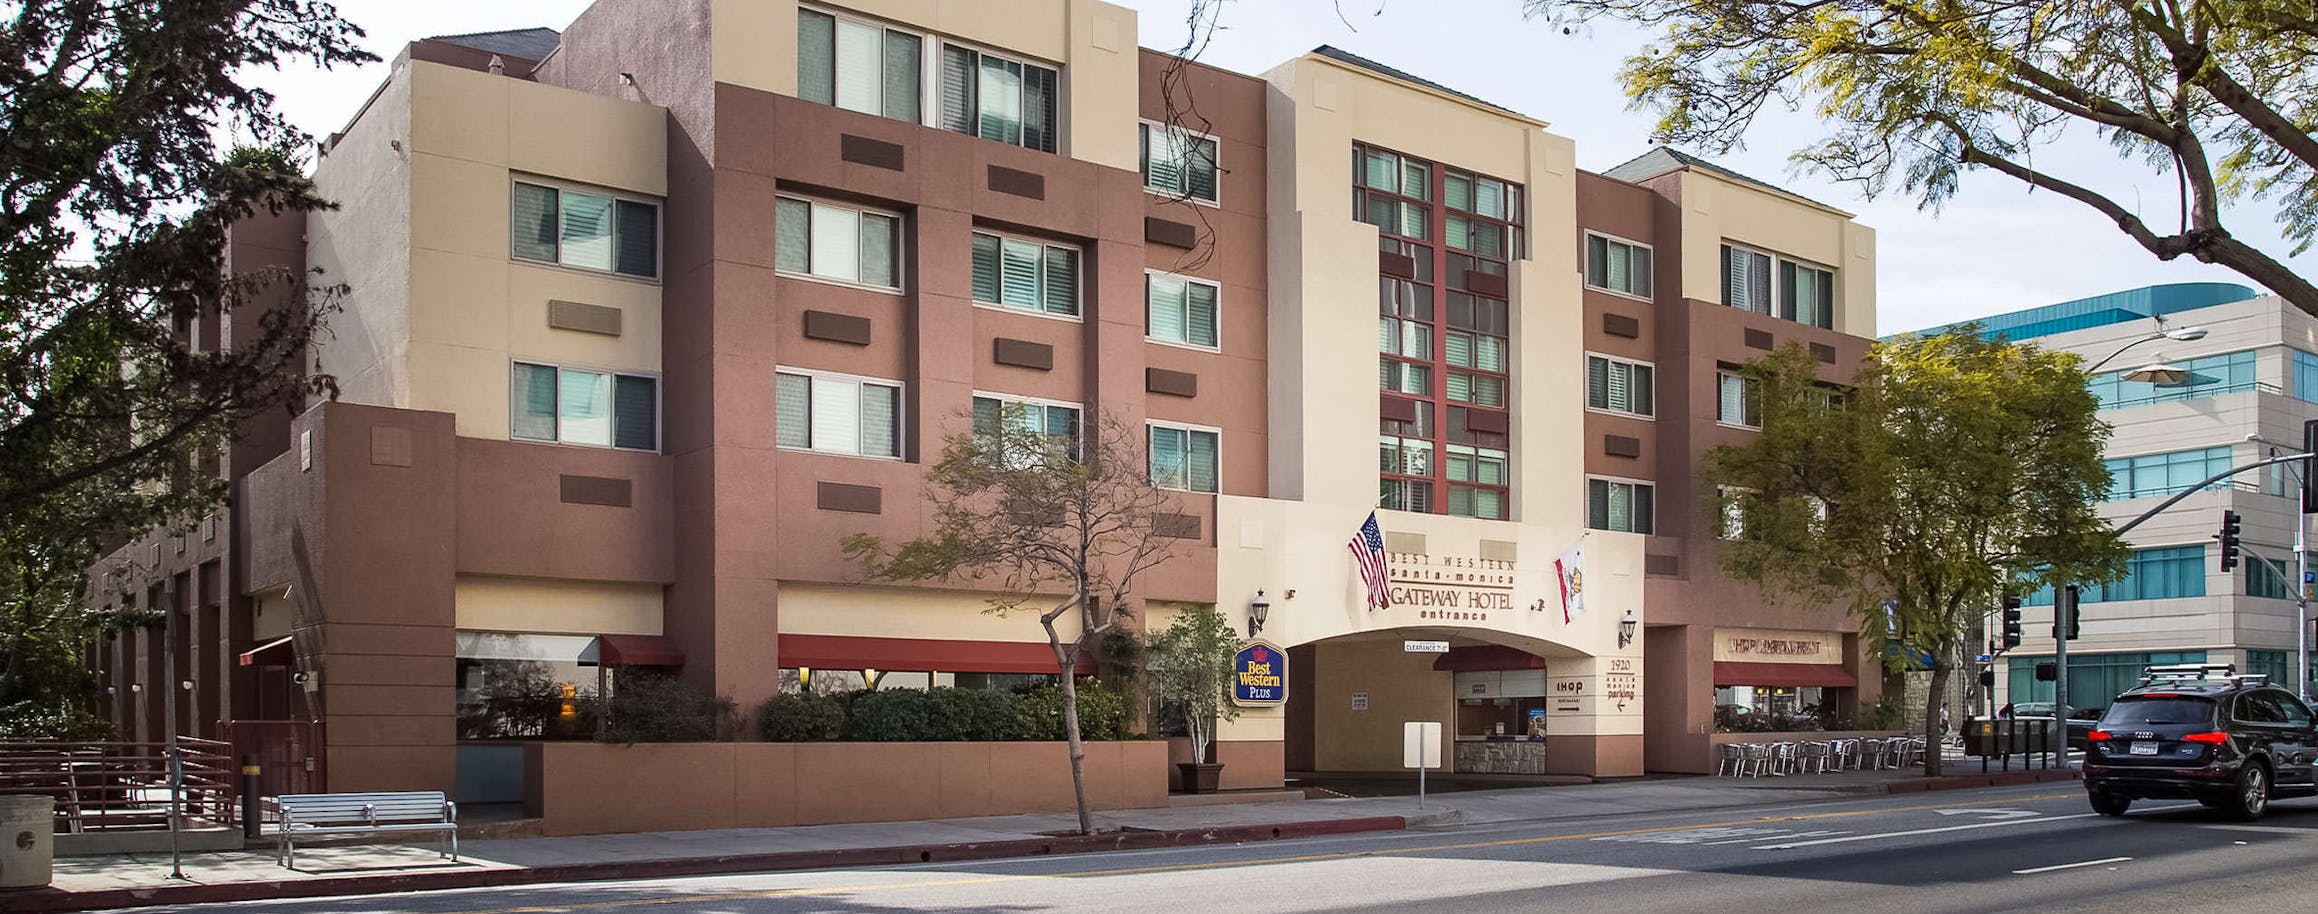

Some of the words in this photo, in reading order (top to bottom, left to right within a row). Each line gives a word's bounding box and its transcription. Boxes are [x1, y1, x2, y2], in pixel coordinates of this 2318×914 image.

[1390, 552, 1429, 565] BEST
[1444, 556, 1514, 570] WESTERN
[1390, 587, 1461, 607] GATEWAY
[1468, 592, 1514, 609] HOTEL
[1420, 609, 1487, 620] entrance
[1247, 660, 1271, 675] Best
[1611, 660, 1631, 671] 1920
[1239, 672, 1280, 687] Western
[1249, 686, 1271, 698] PLUS
[1607, 689, 1635, 700] parking
